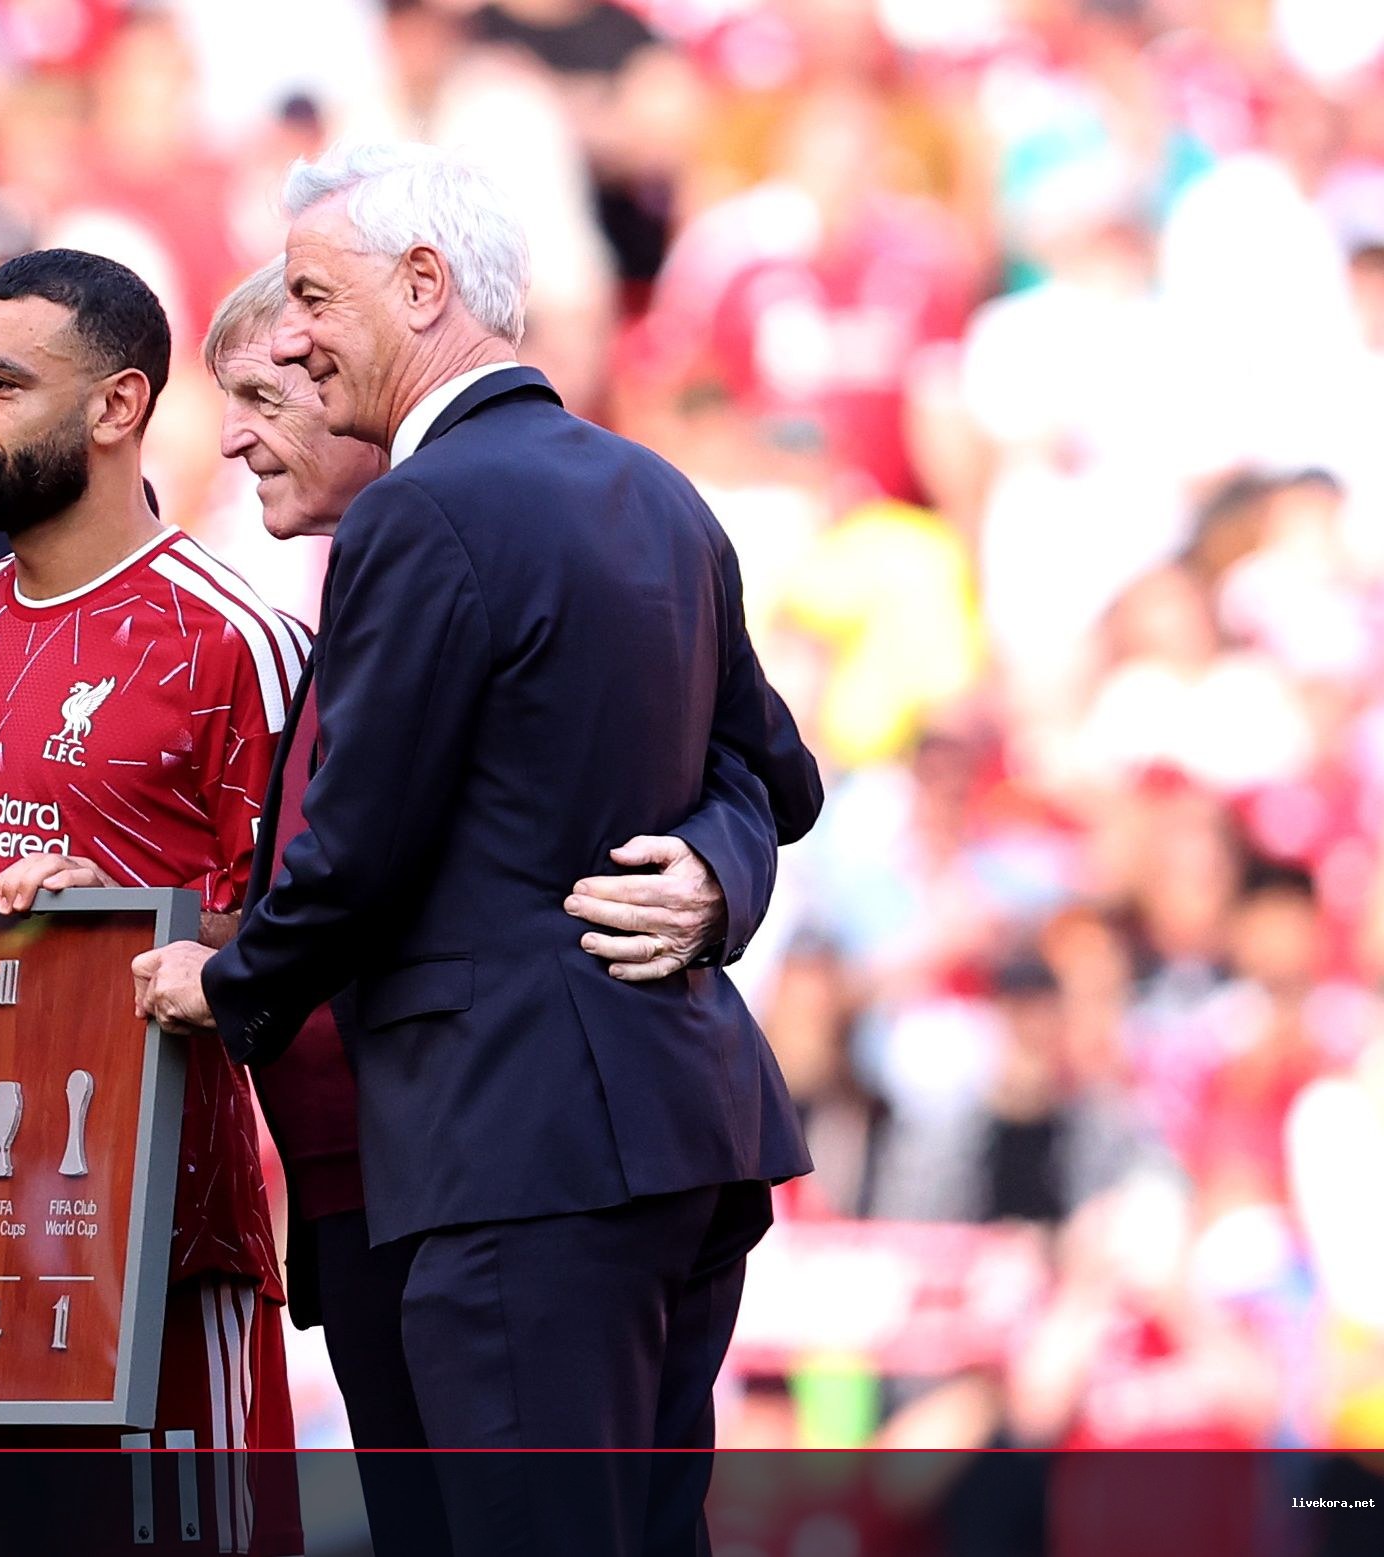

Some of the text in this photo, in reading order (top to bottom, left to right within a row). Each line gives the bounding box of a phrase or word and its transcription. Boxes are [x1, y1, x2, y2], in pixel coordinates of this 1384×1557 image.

[49, 1200, 97, 1216] FIFA Club
[0, 1221, 26, 1239] Cups
[45, 1220, 98, 1239] World Cup
[51, 1295, 70, 1350] 1
